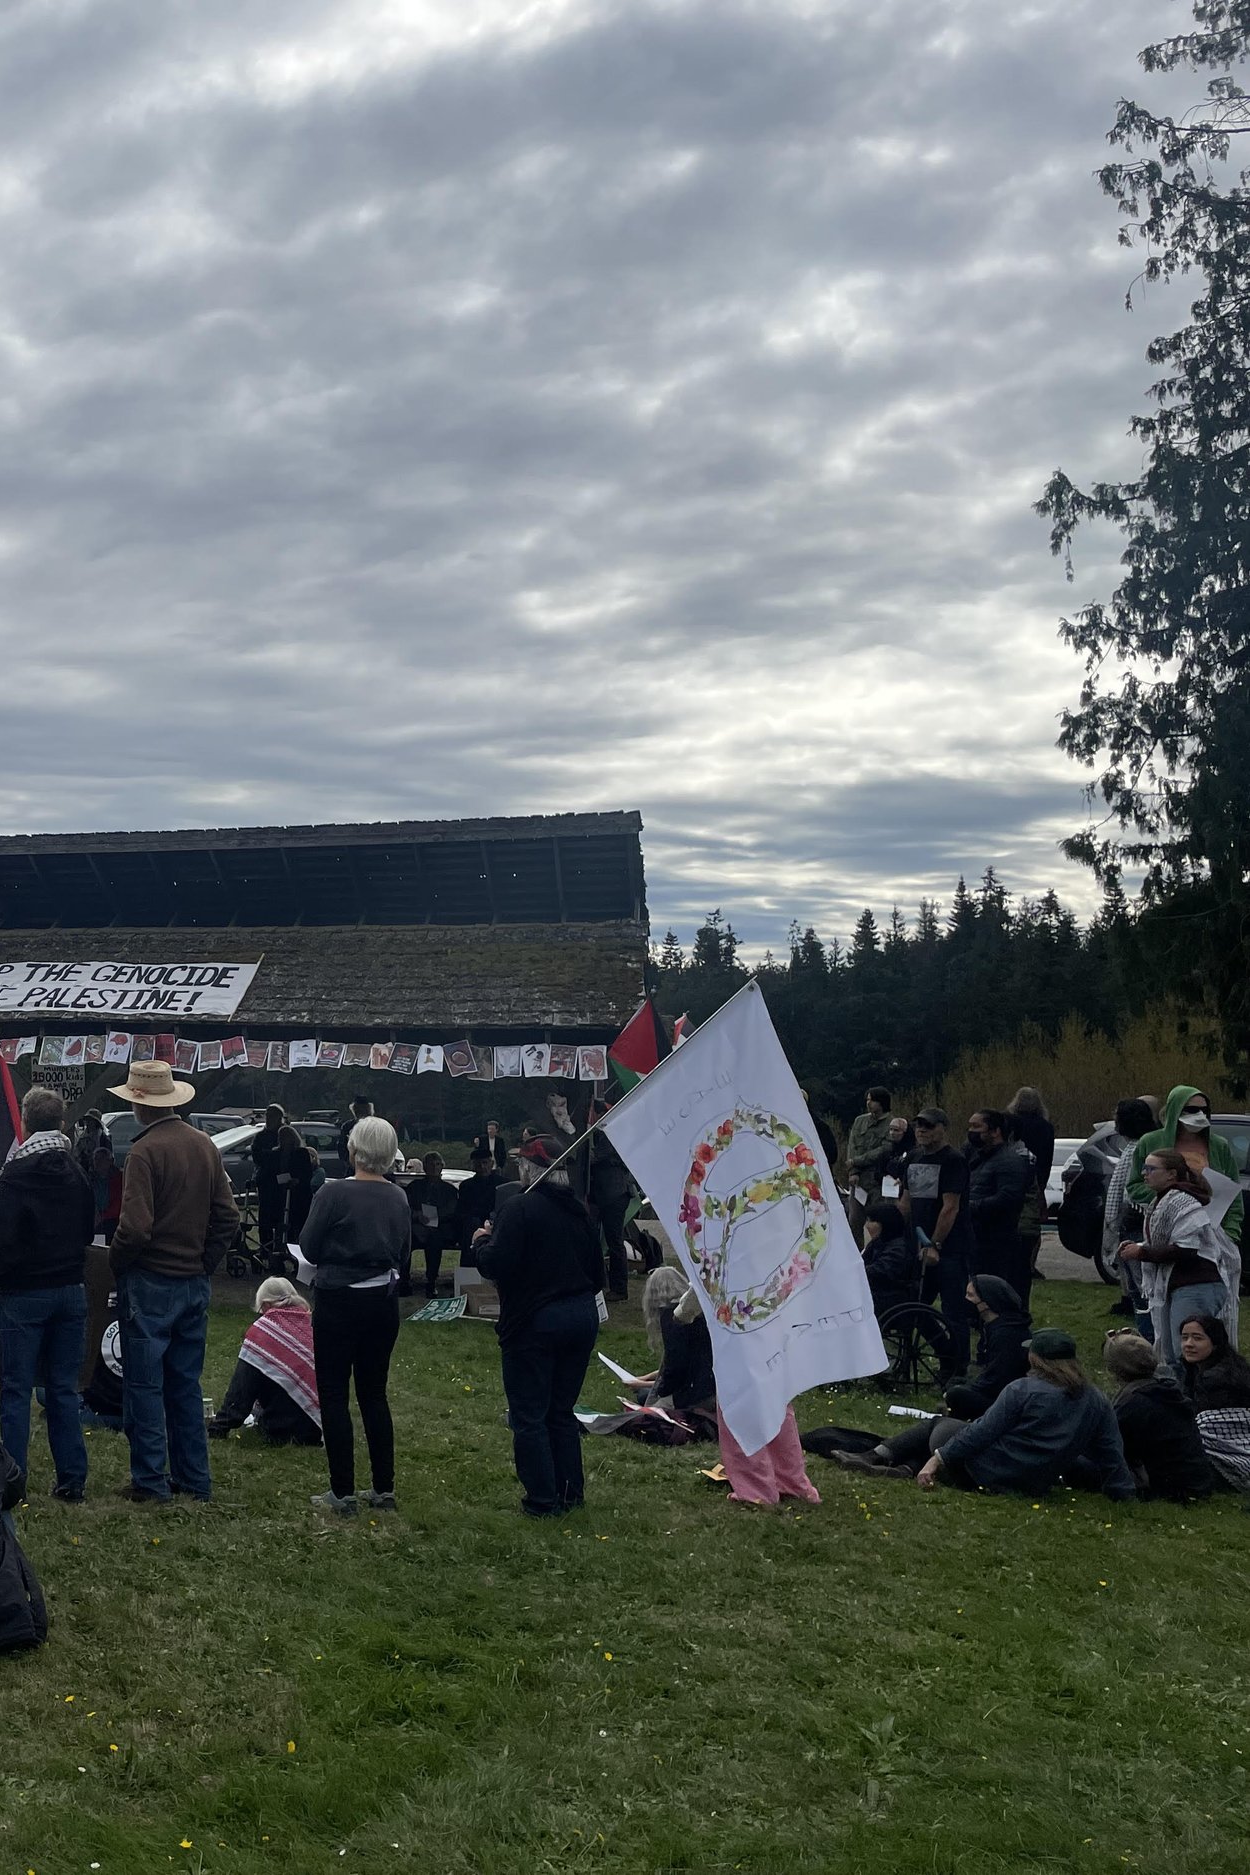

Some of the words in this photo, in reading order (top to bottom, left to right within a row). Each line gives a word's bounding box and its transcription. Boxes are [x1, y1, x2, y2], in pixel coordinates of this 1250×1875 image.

[23, 963, 91, 983] THE
[90, 964, 240, 989] GENOCIDE
[17, 987, 204, 1013] PALESTINE!
